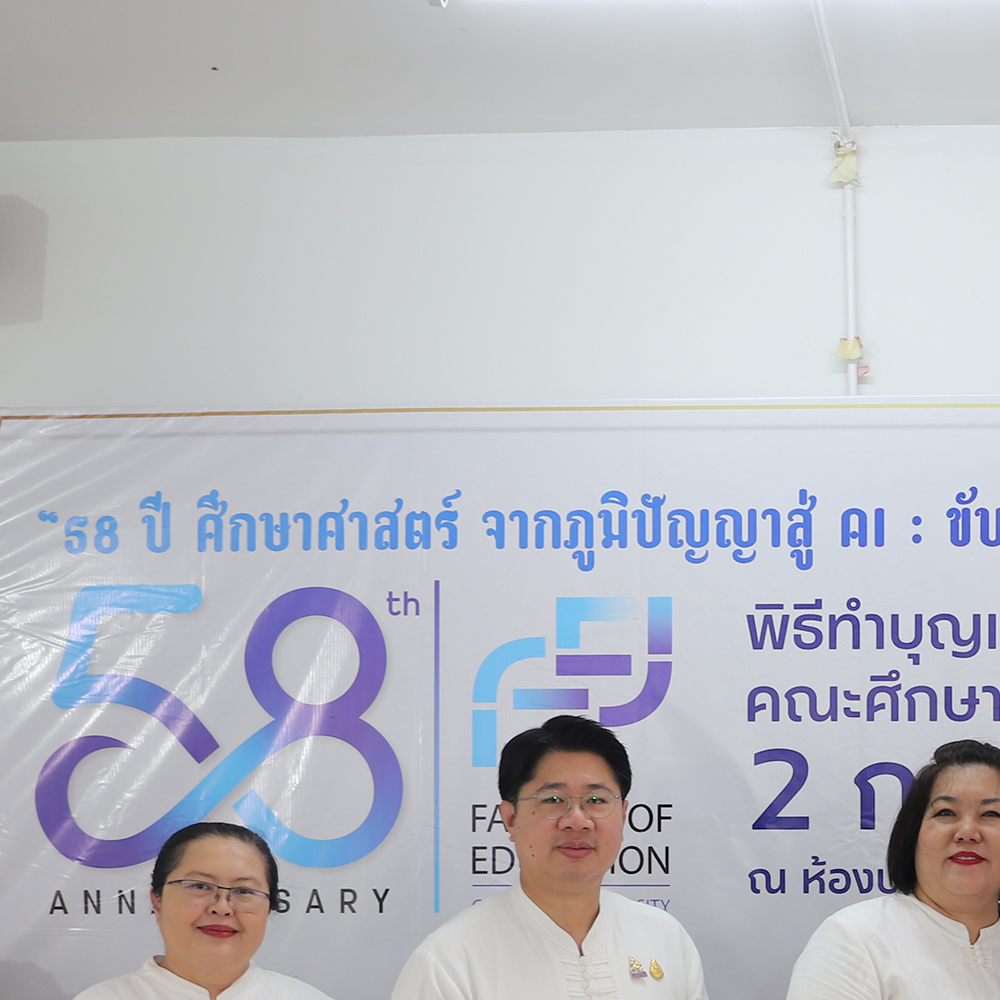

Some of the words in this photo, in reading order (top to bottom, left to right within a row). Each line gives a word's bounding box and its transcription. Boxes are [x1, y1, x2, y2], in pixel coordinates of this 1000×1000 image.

[139, 490, 171, 554] ปี
[197, 489, 462, 553] ศึกษาศาสตร์
[482, 488, 817, 572] จากภูมิปัญญาสู่
[386, 591, 420, 616] th
[752, 748, 810, 830] 2
[628, 803, 673, 833] OF
[748, 868, 786, 894] ณ
